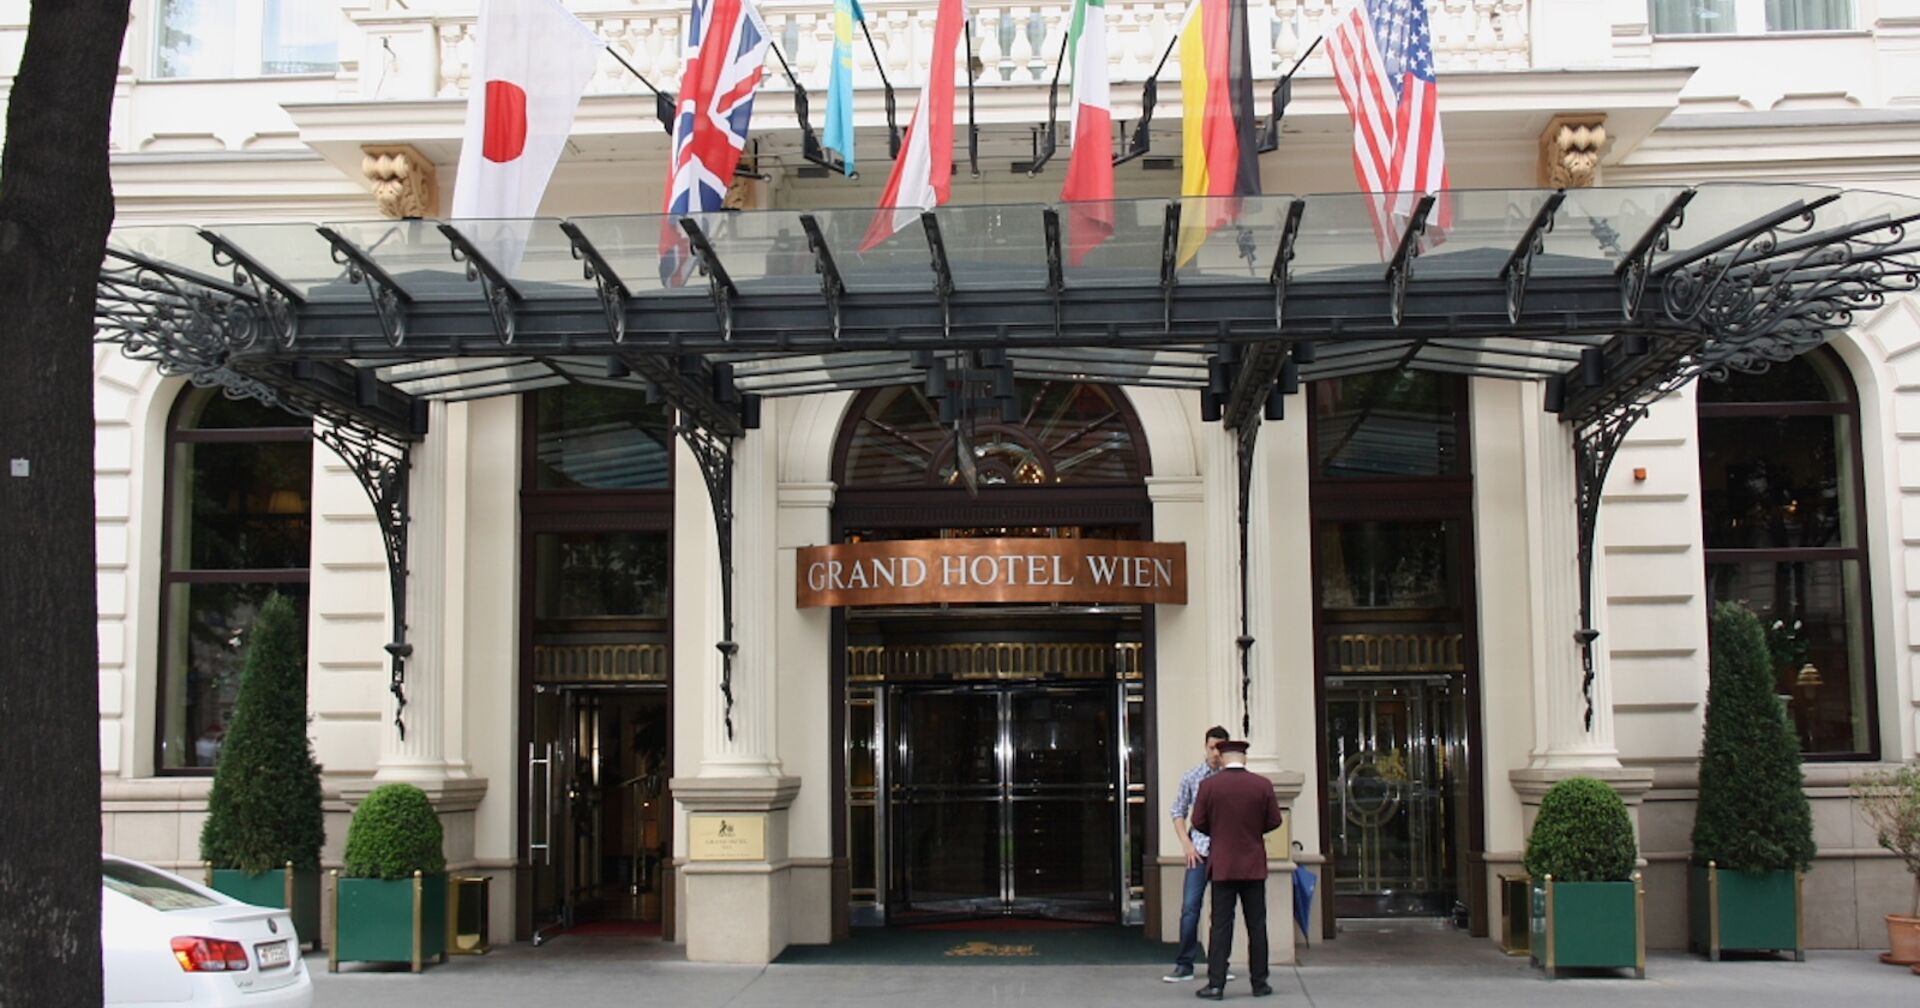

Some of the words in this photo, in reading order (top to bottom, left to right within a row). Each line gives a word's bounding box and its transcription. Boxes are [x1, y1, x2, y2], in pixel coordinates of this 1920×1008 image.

[808, 558, 928, 591] GRAND
[942, 554, 1074, 586] HOTEL
[1086, 555, 1173, 587] WIEN
